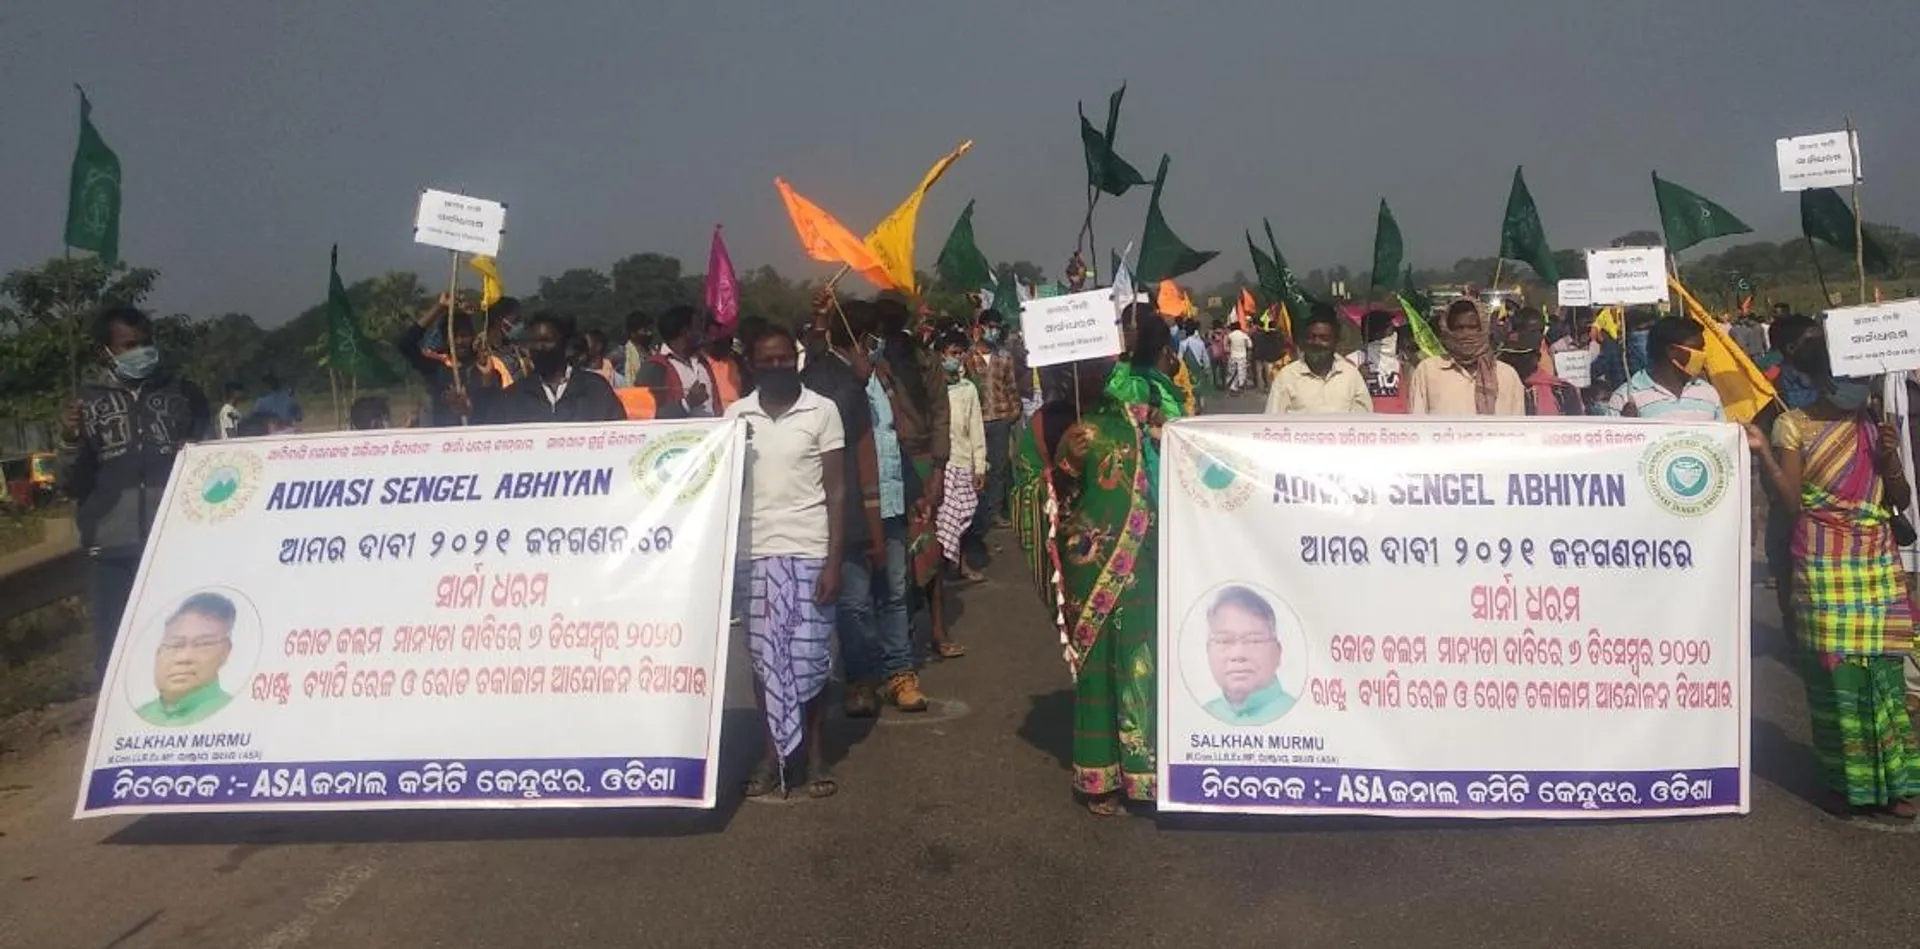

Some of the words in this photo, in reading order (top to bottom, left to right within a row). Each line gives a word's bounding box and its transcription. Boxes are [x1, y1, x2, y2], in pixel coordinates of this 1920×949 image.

[266, 478, 374, 510] ADIVASI
[380, 473, 482, 505] SENGEL
[494, 467, 614, 500] ABHIYAN
[1387, 473, 1495, 506] SENGEL
[1507, 472, 1626, 507] ABHIYAN
[278, 534, 347, 565] ଆମର
[358, 531, 417, 559] ଦାବୀ
[430, 527, 512, 557] ୨୦୨୧
[1300, 535, 1369, 565] ଆମର
[1381, 535, 1439, 566] ଦାବୀ
[1454, 536, 1536, 566] ୨୦୨୧
[1549, 537, 1693, 569] ଜନଗଣନାରେ
[491, 570, 550, 609] ଧରମ
[1526, 584, 1581, 623] ଧରମ
[284, 628, 332, 657] କୋଡ
[336, 626, 383, 655] କଲମ
[462, 612, 522, 653] ଦାବିରେ
[626, 622, 683, 648] ୨୦୨୦
[1330, 634, 1375, 662] କୋଡ
[1382, 635, 1427, 664] କଲମ
[1503, 627, 1563, 666] ଦାବିରେ
[1659, 639, 1711, 665] ୨୦୨୦
[422, 667, 470, 697] ରୋଡ
[1473, 680, 1520, 711] ରୋଡ
[114, 734, 188, 751] SALKHAN
[191, 732, 252, 748] MURMU
[1190, 733, 1263, 749] SALKHAN
[1268, 735, 1325, 751] MURMU
[112, 768, 221, 799] ନିବେଦକ
[398, 761, 468, 794] କମିଟି
[1201, 768, 1306, 800] ନିବେଦକ
[1466, 773, 1530, 803] କମିଟି
